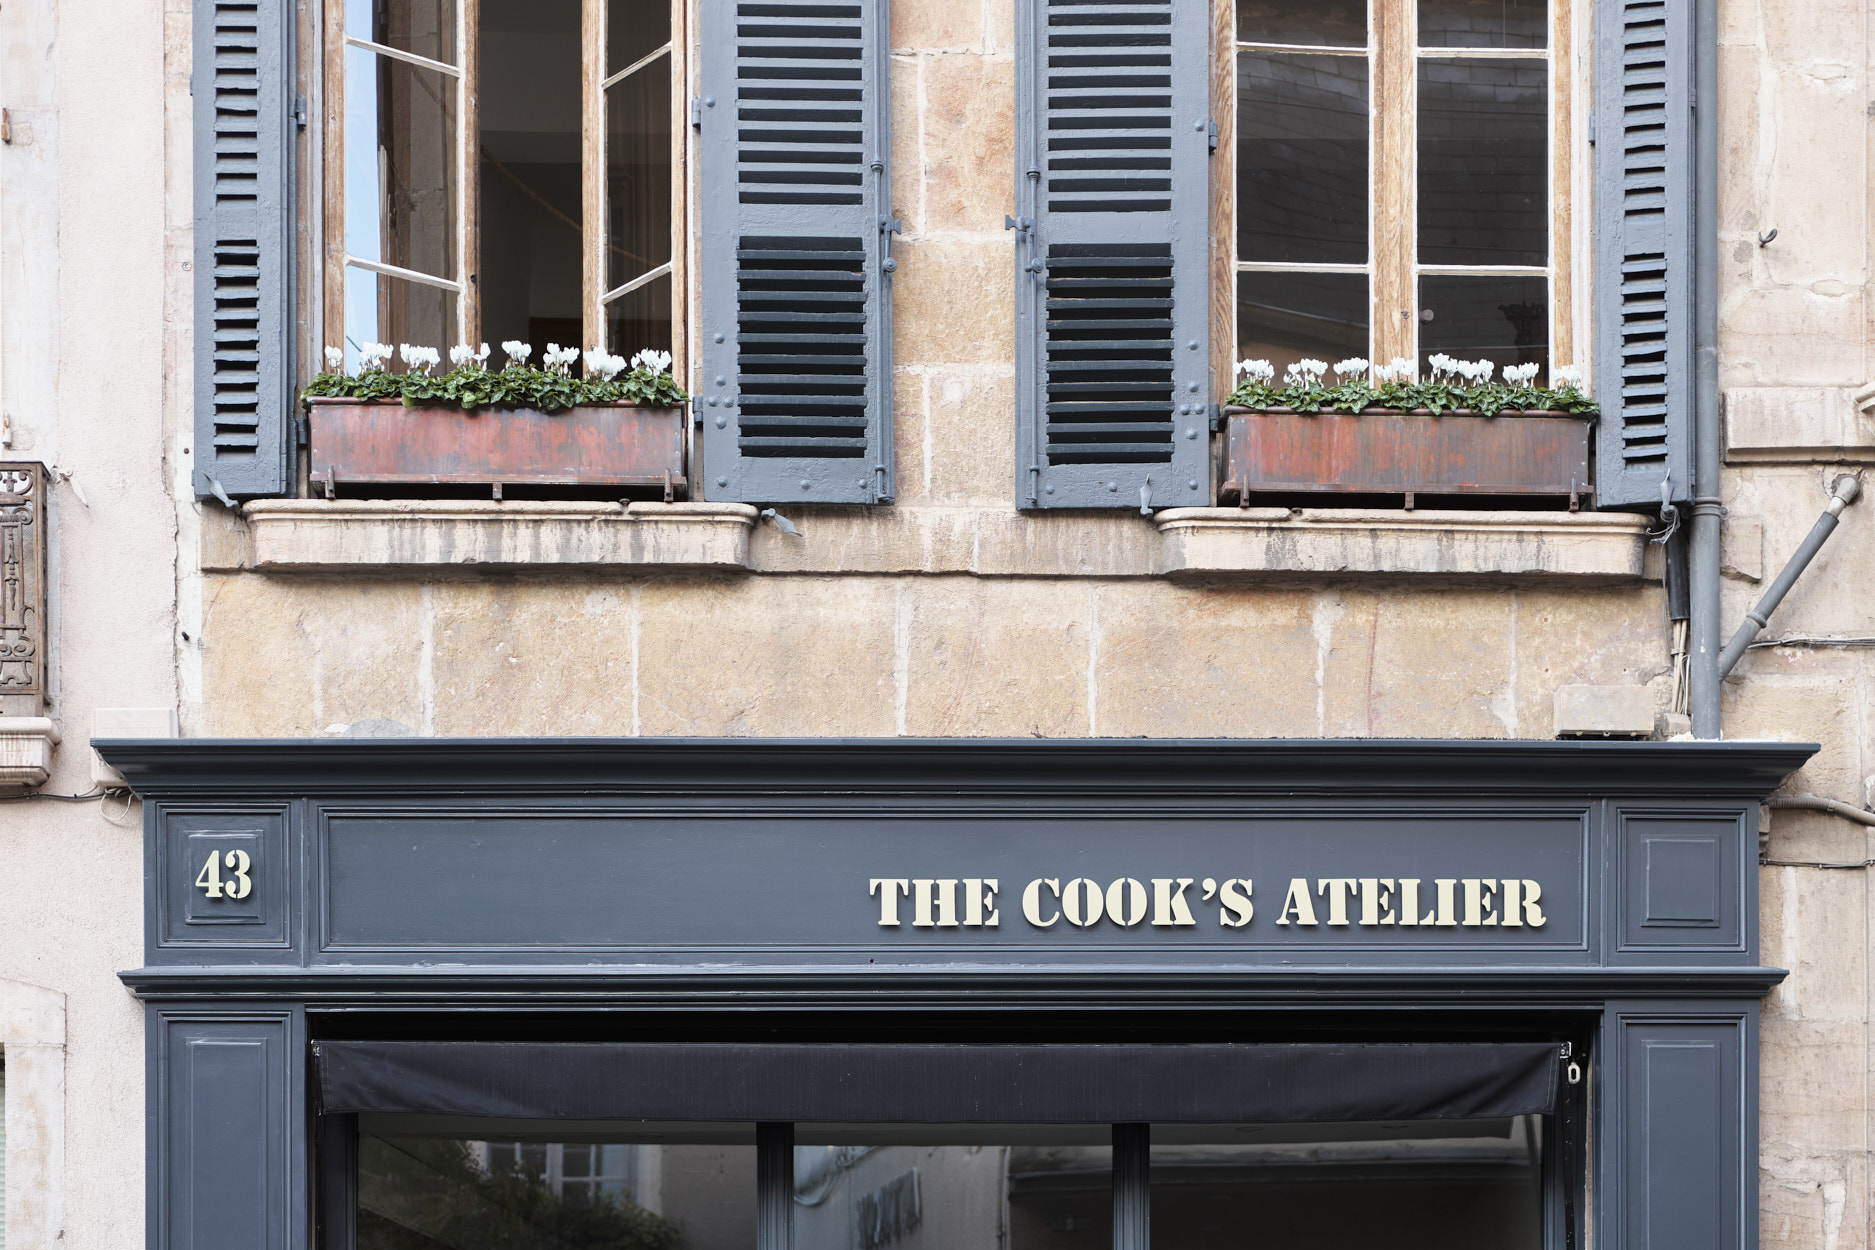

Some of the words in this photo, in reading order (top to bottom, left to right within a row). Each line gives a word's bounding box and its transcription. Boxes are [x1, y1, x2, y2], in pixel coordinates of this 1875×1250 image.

[195, 849, 252, 900] 43
[869, 878, 1000, 927] THE
[1022, 877, 1254, 927] COOK’S
[1275, 878, 1547, 928] ATELIER
